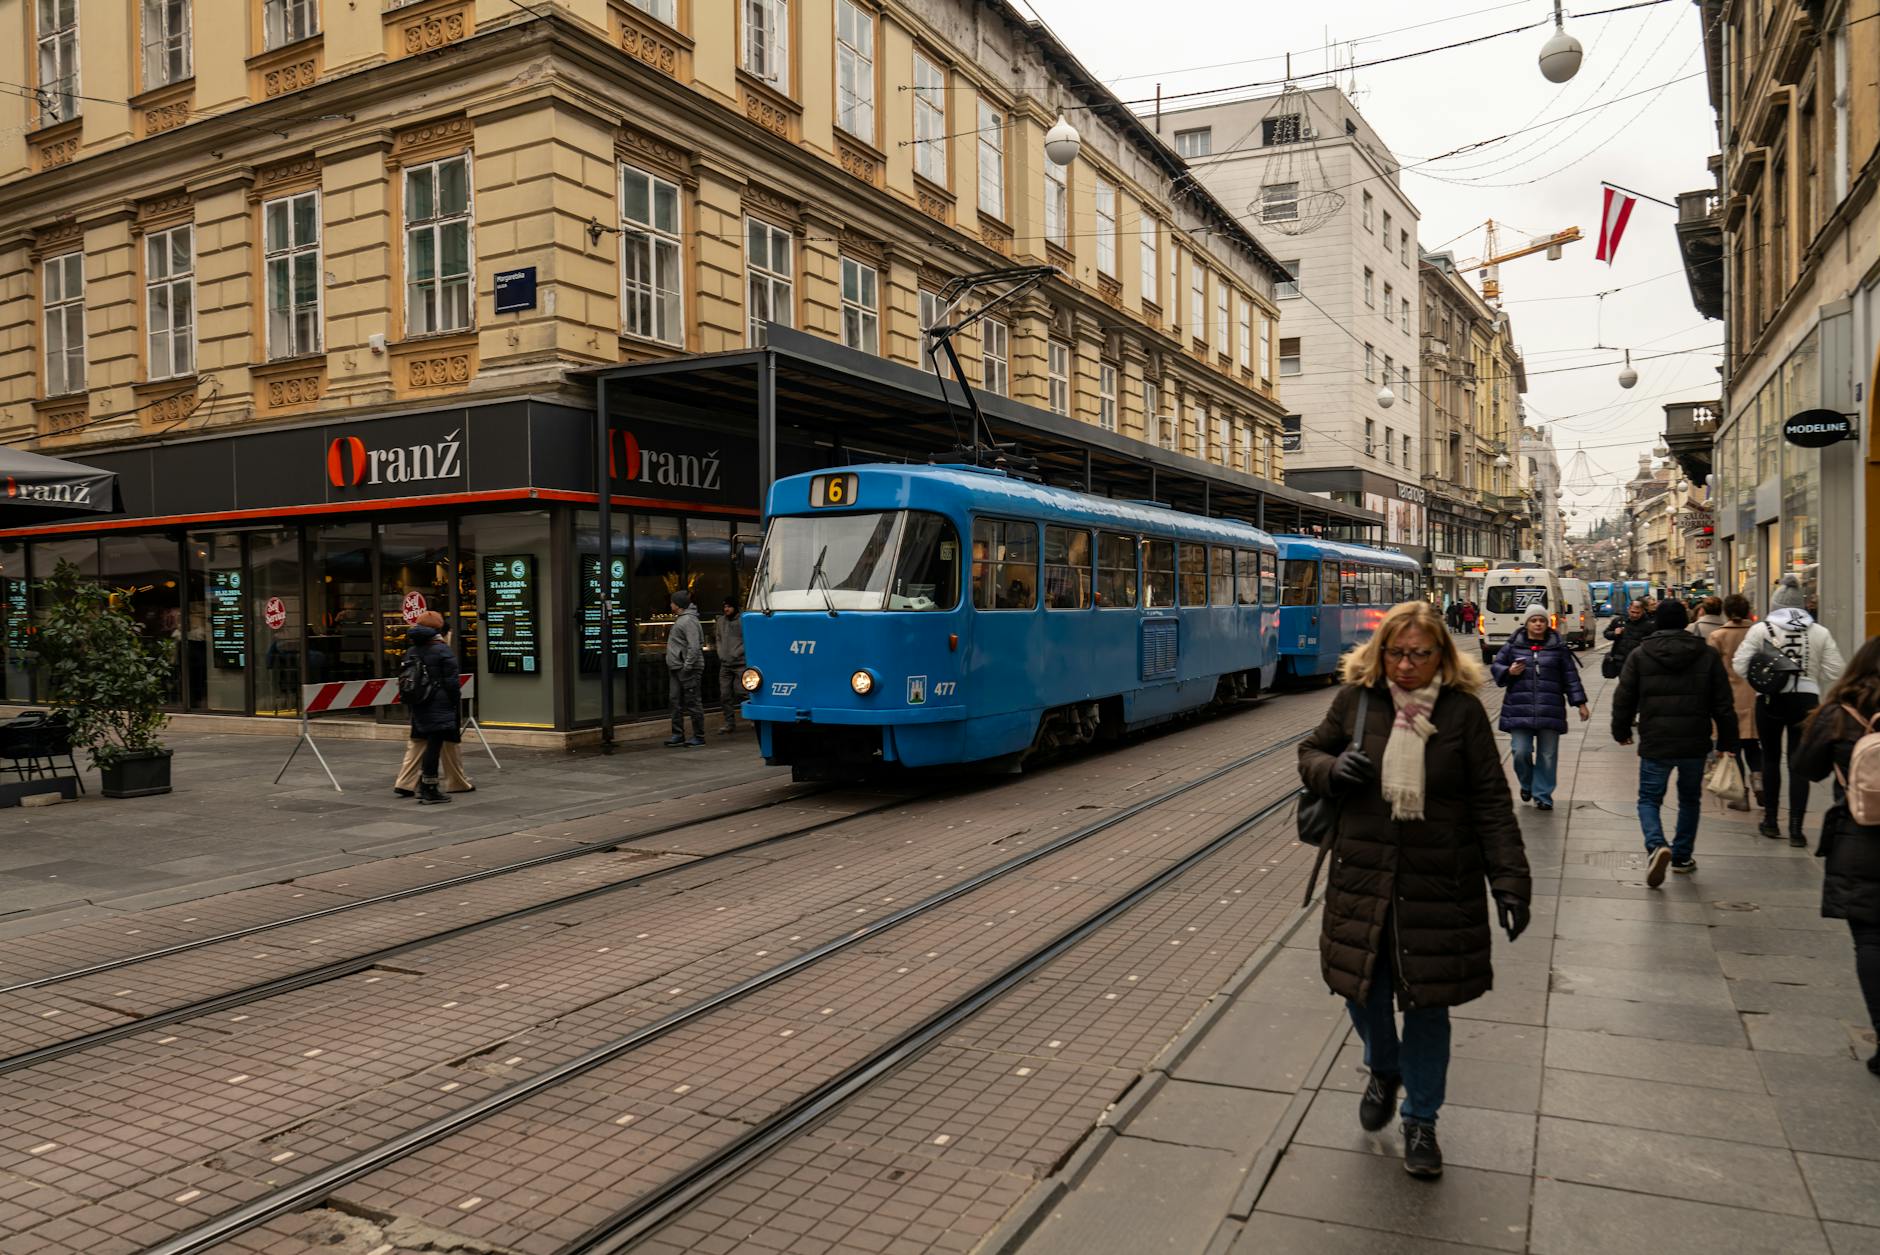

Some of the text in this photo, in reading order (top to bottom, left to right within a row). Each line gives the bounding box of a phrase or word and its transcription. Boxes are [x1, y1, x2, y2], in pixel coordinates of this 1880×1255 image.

[1786, 421, 1847, 434] MODELINE
[327, 428, 462, 489] Oranž
[828, 477, 843, 502] 6
[790, 640, 816, 654] 477
[772, 682, 797, 696] ZET
[934, 682, 957, 696] 477
